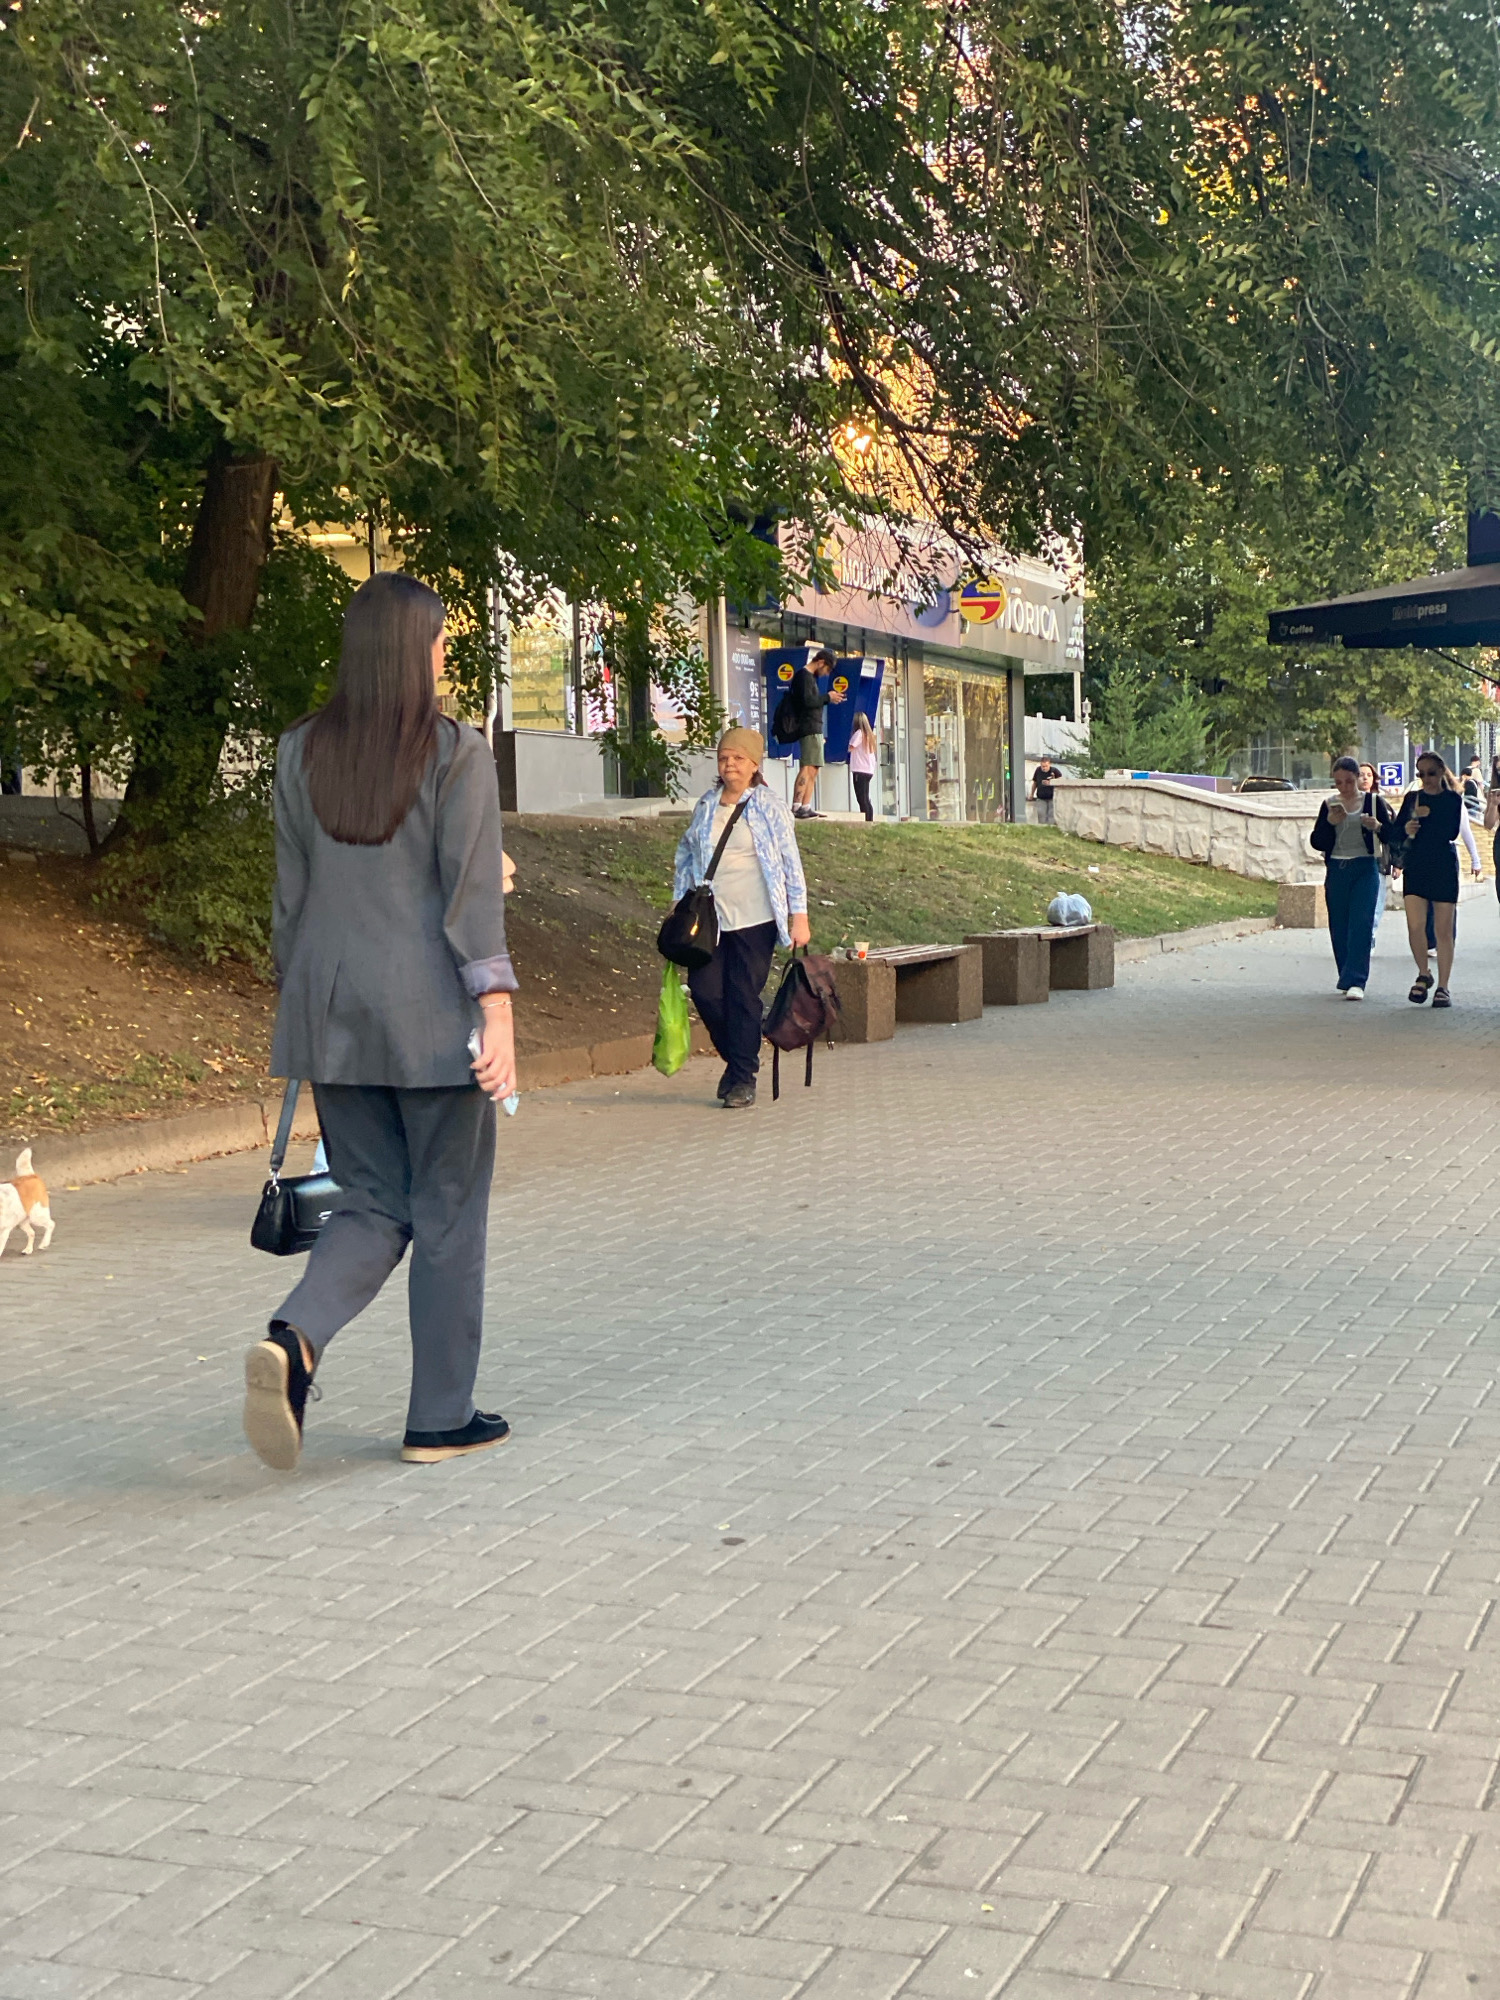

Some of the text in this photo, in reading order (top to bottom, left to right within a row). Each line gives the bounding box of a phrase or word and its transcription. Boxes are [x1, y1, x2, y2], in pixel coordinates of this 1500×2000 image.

[842, 557, 938, 607] MOLDINDCONBA
[1289, 624, 1314, 635] Coffee
[1385, 769, 1398, 785] P
